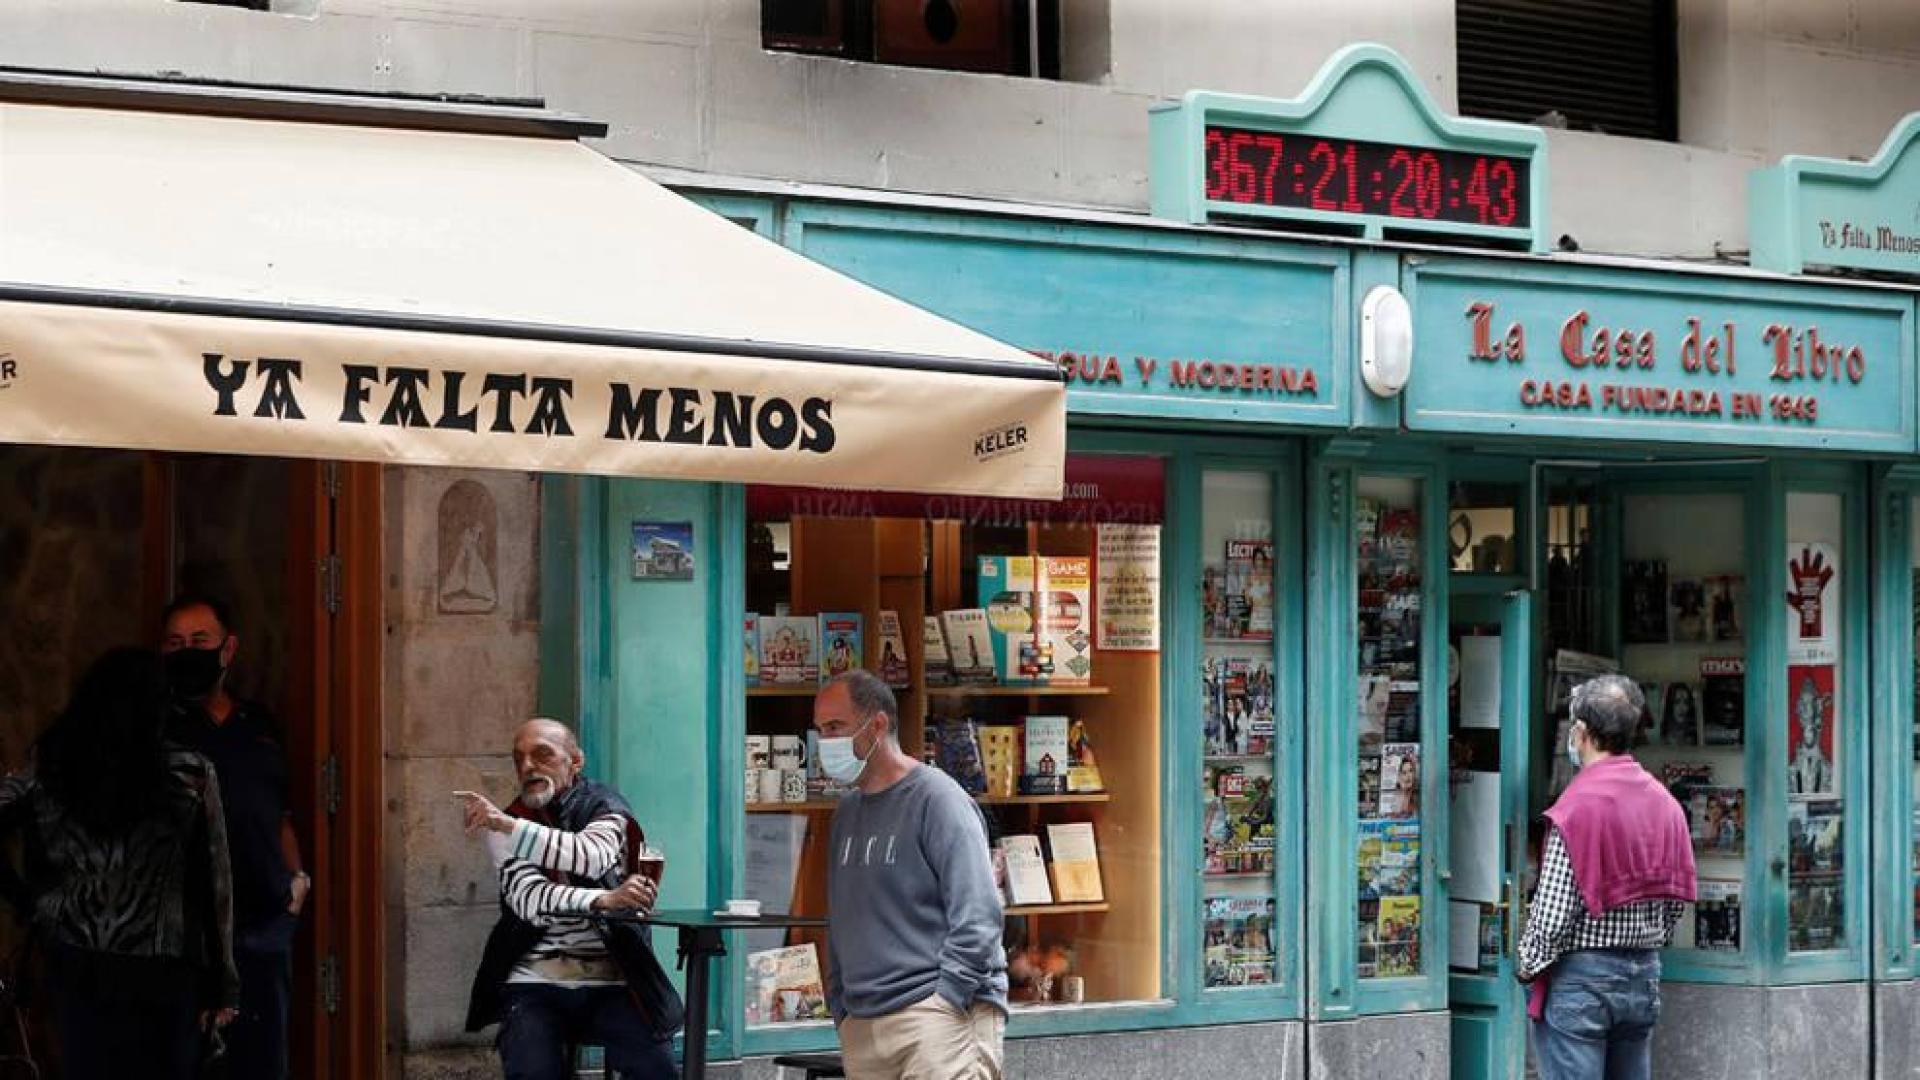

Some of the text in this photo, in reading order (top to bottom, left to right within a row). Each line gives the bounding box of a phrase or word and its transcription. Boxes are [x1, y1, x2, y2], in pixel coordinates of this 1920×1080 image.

[1206, 130, 1516, 226] 367:21:20:43
[1819, 222, 1837, 249] Ya
[1840, 222, 1872, 250] Falta
[1465, 302, 1866, 384] La Casa del Libro
[1135, 355, 1157, 388] Y
[1170, 358, 1319, 399] MODERNA
[1520, 378, 1593, 409] CASA
[1602, 384, 1722, 420] FUNDADA
[1731, 391, 1762, 420] EN
[202, 353, 836, 453] YA FALTA MENOS
[974, 426, 1028, 456] KELER
